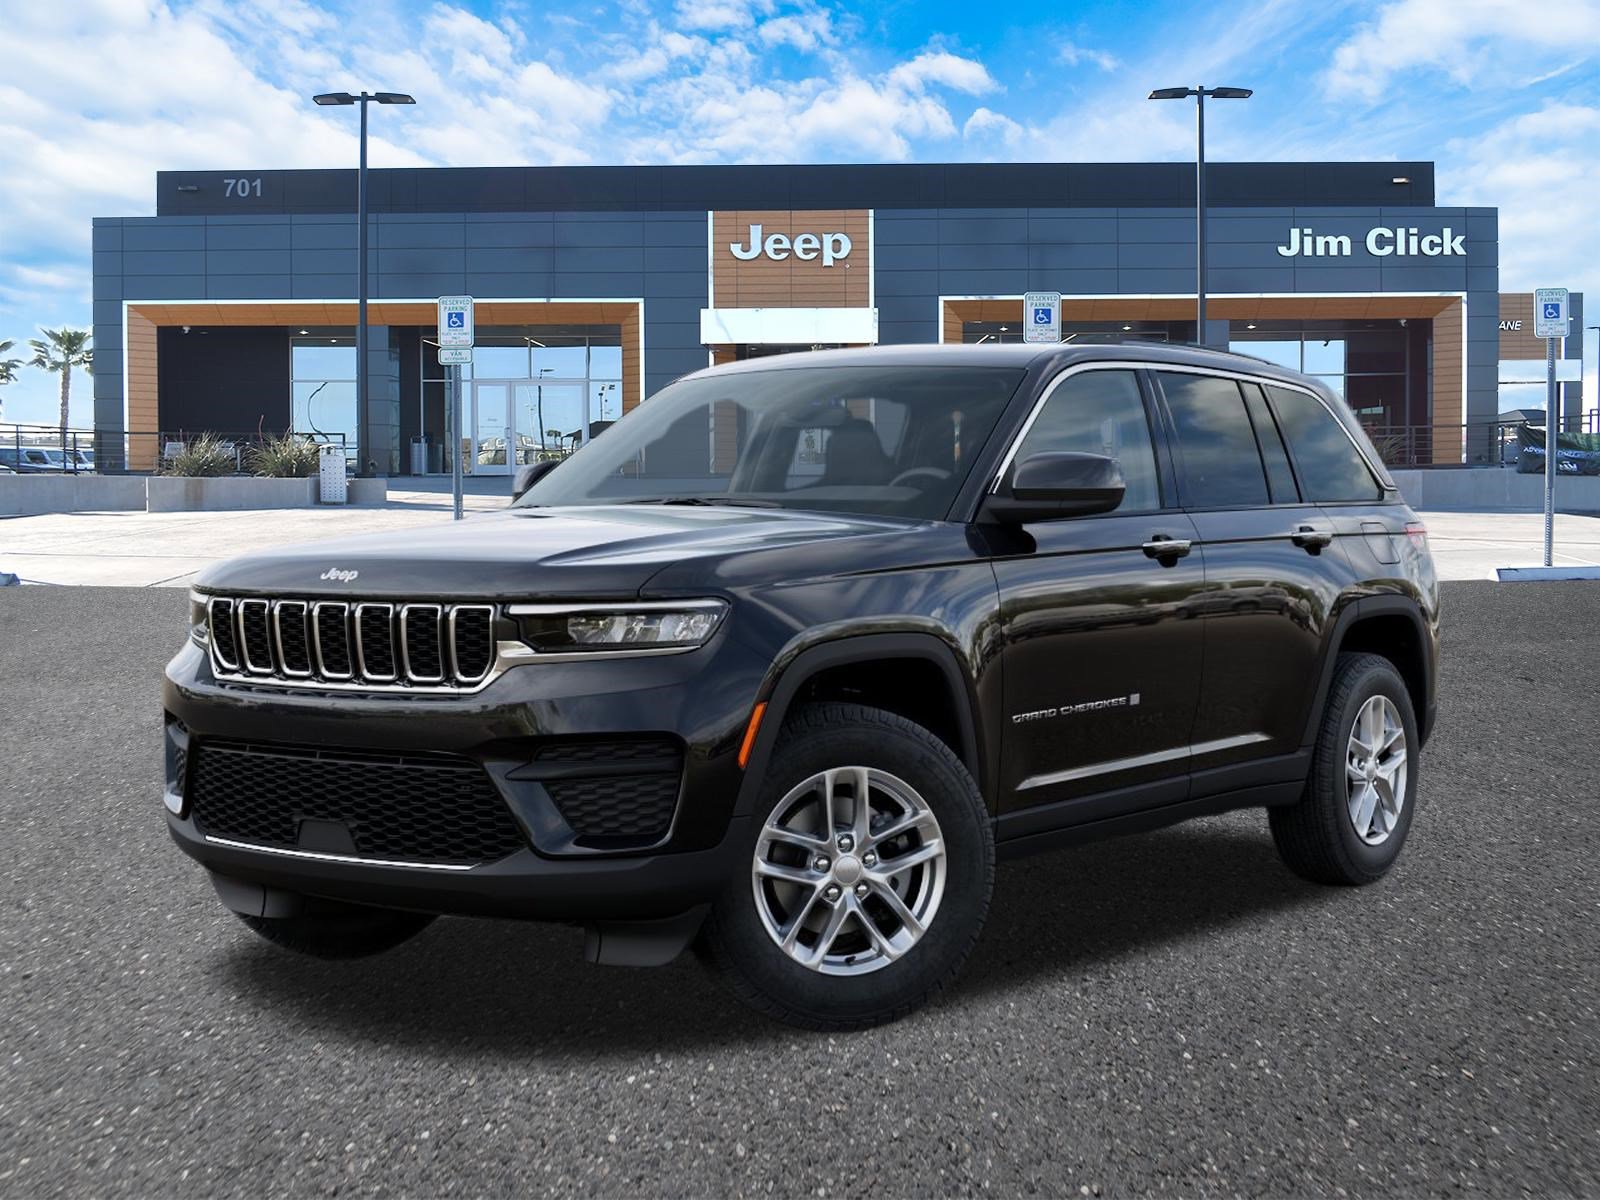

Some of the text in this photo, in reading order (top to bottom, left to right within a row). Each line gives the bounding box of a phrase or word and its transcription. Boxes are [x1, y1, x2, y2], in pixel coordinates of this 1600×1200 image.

[223, 178, 262, 197] 701
[730, 224, 852, 267] Jeep
[1277, 227, 1467, 257] Jim Click
[320, 567, 359, 583] Jeep
[1012, 697, 1127, 723] GRAND CHEROKEE
